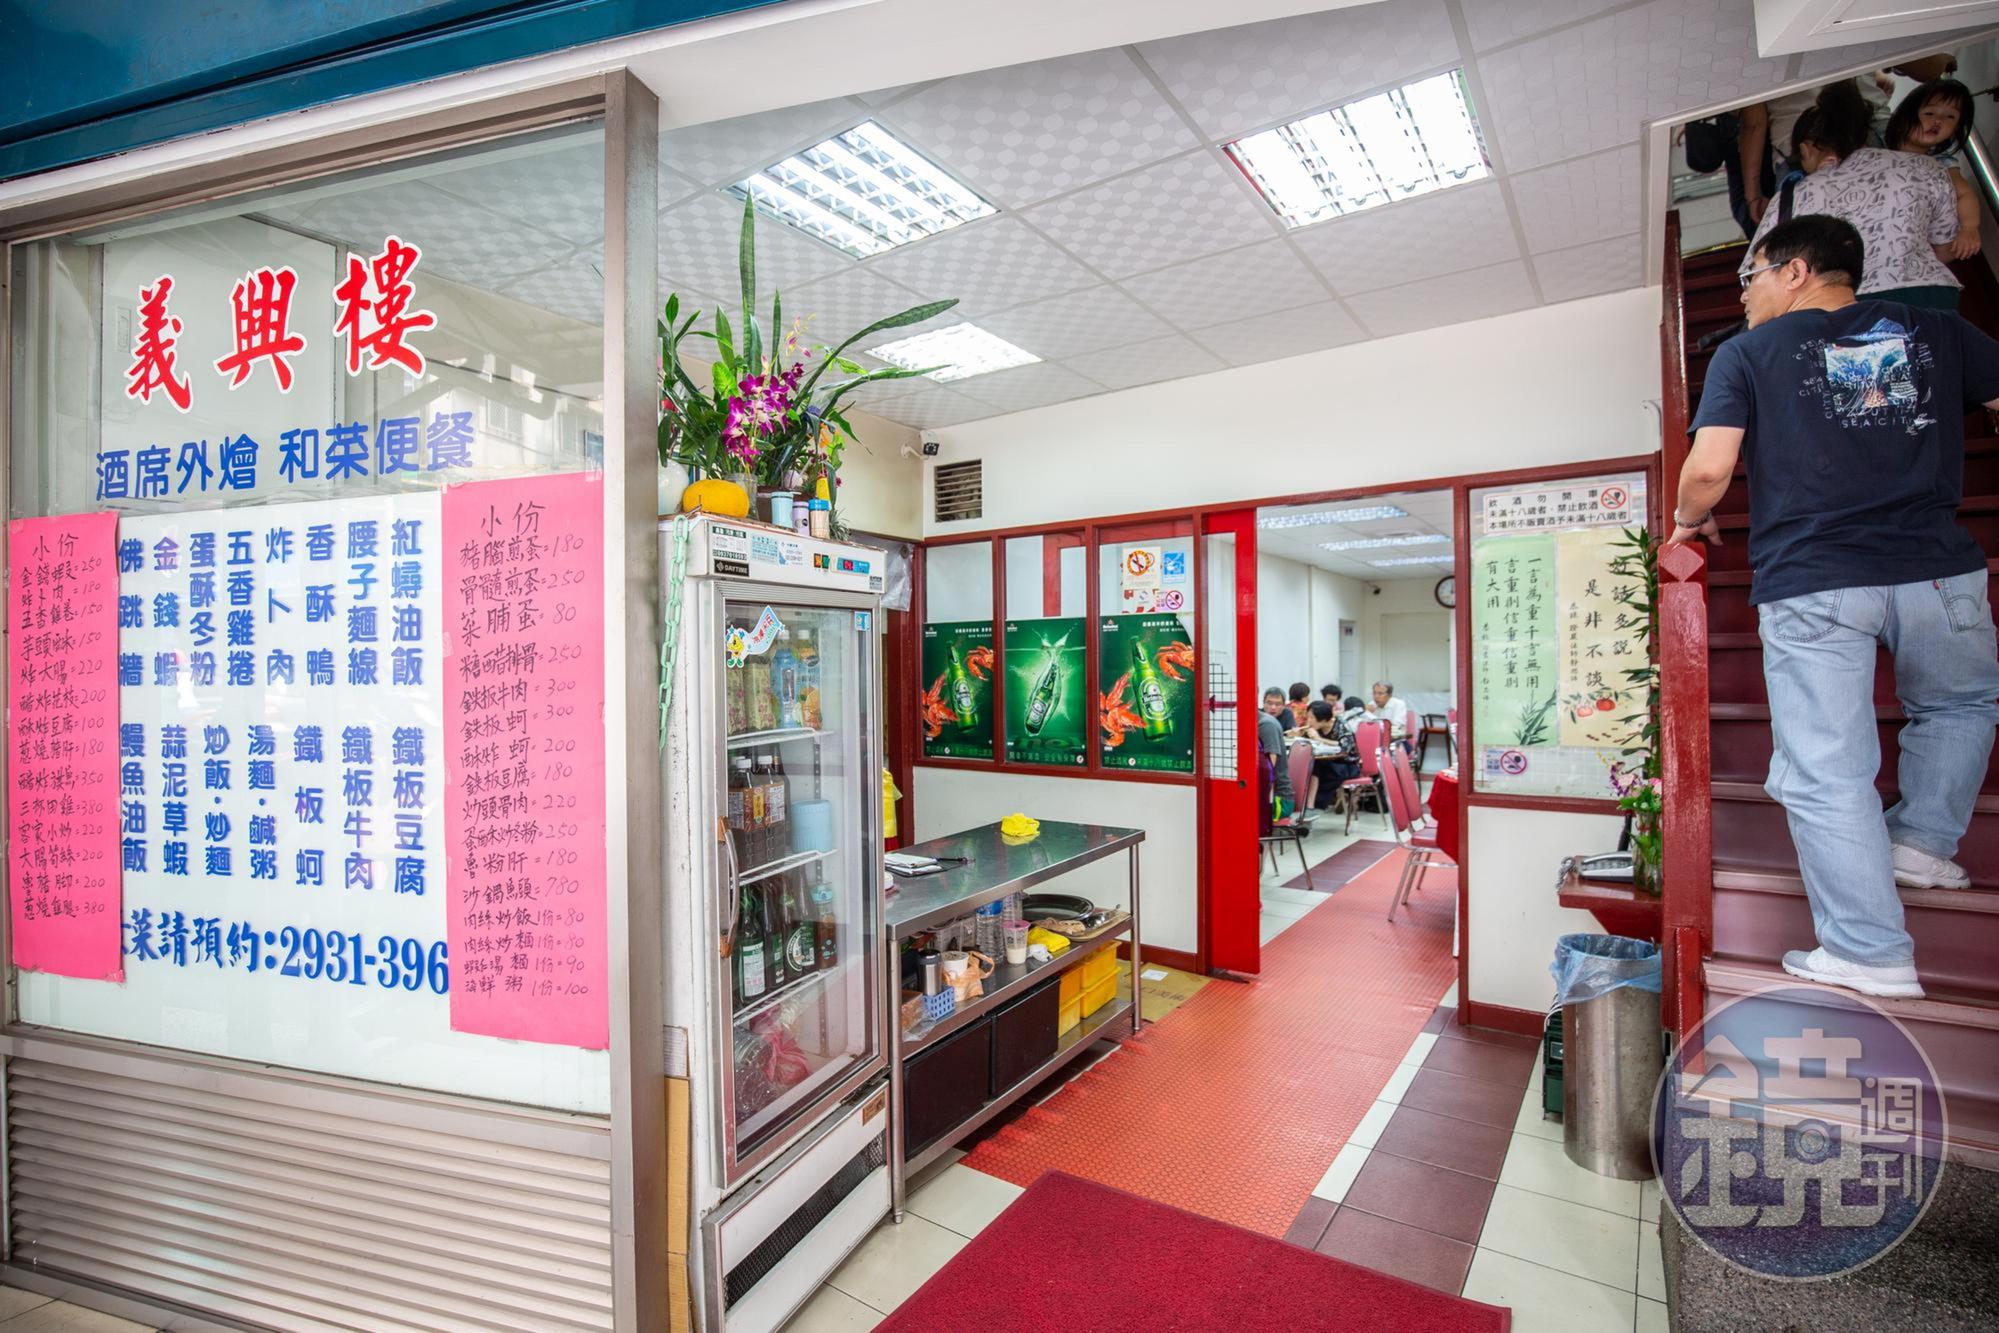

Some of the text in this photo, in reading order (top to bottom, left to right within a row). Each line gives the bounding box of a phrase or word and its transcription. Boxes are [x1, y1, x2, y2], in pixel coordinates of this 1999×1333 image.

[125, 234, 437, 413] 義興樓
[95, 411, 476, 501] 酒席外燴 和菜便餐
[480, 501, 546, 537] 小份
[33, 533, 79, 561] 小份
[118, 537, 144, 687] 佛跳牆
[153, 535, 180, 687] 金錢蝦
[189, 531, 216, 687] 蛋酥冬粉
[226, 529, 255, 687] 五香雞捲
[265, 526, 295, 686] 炸卜肉
[305, 523, 336, 687] 香酥鴨
[347, 520, 379, 687] 腰子麵線
[391, 518, 424, 687] 紅蟳油飯
[1485, 560, 1500, 609] 有大用
[1585, 579, 1605, 687] 是非不談
[120, 723, 147, 874] 鰻魚油飯
[160, 724, 189, 876] 蒜泥草蝦
[293, 724, 325, 887] 鐵板蚵
[341, 726, 374, 891] 鐵板牛肉
[391, 726, 427, 896] 鐵板豆腐
[121, 906, 449, 995] 菜請預約:2931-396
